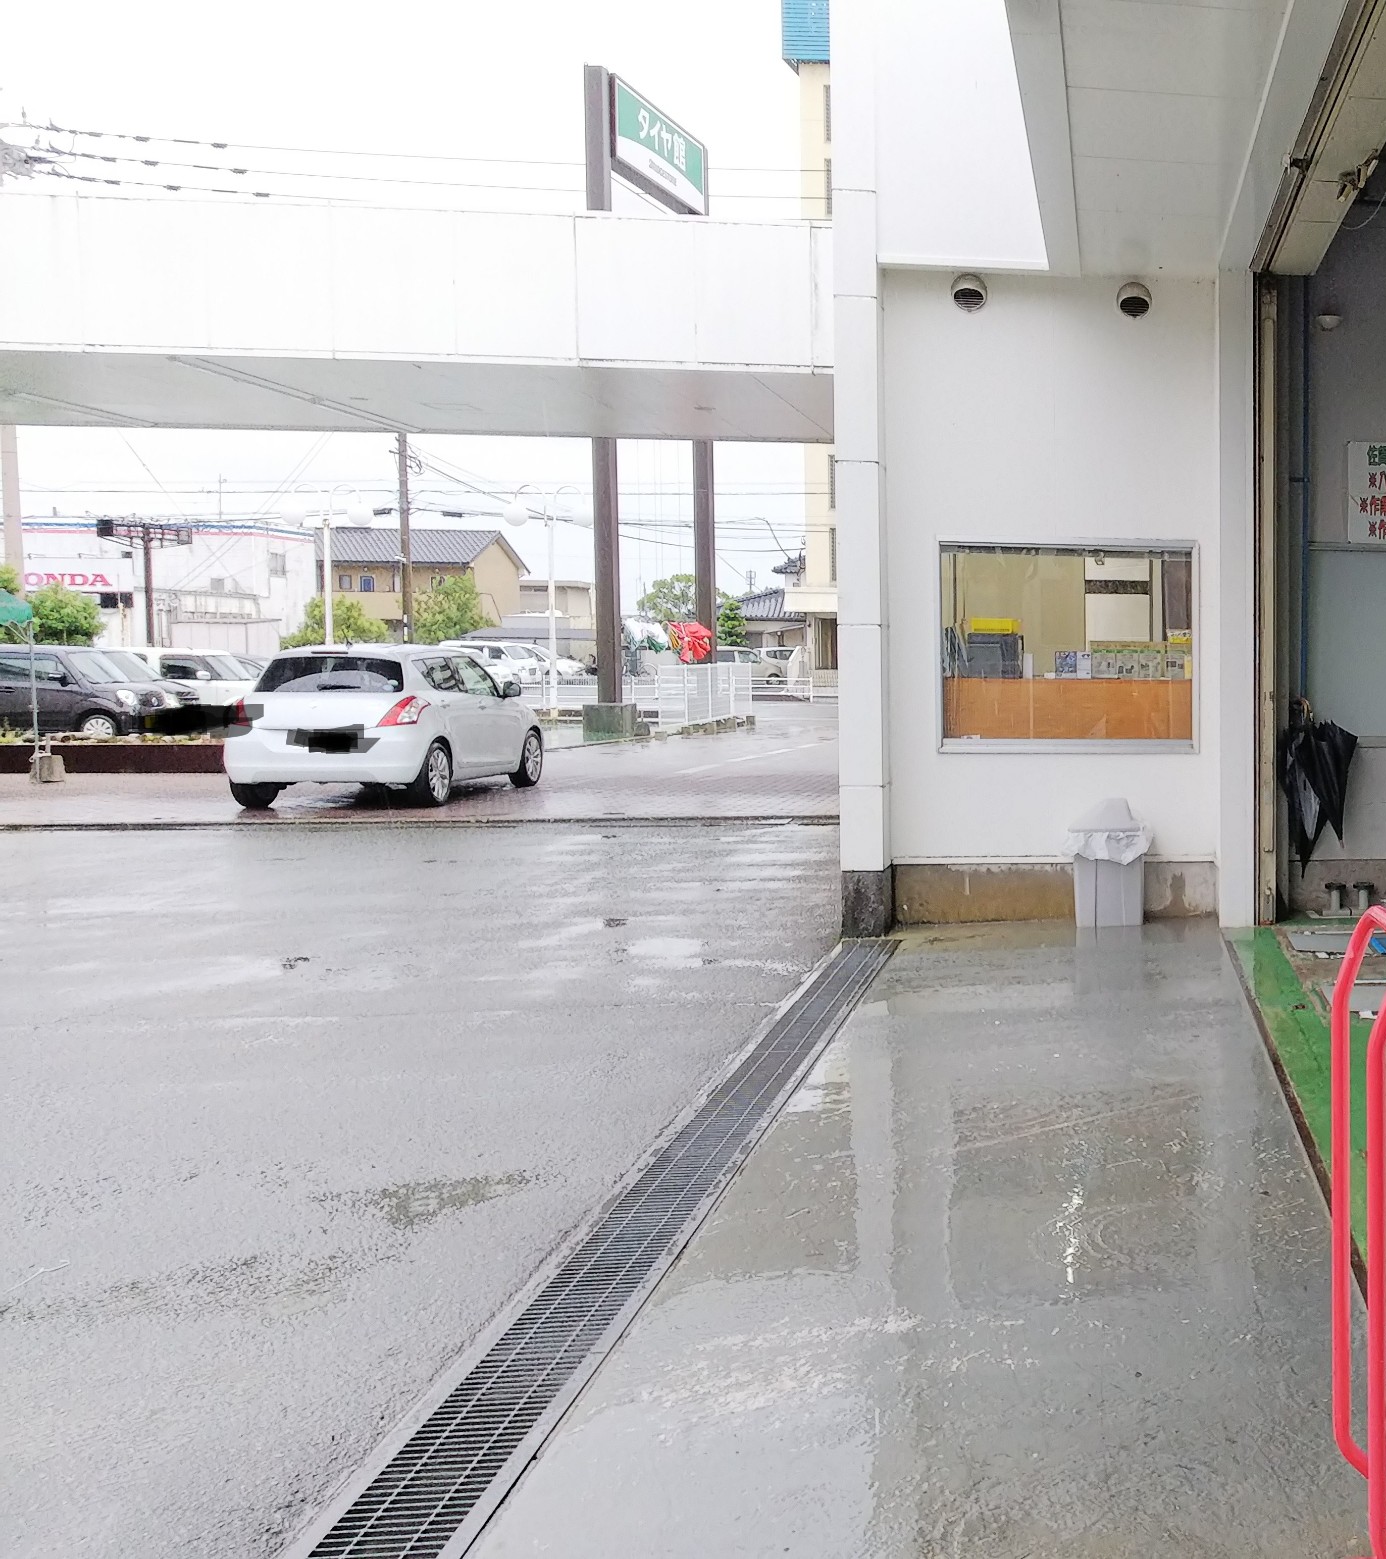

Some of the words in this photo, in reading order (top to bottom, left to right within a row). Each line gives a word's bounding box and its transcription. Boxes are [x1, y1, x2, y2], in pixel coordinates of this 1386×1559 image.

[638, 107, 686, 172] タイヤ館
[23, 572, 113, 588] ONDA
